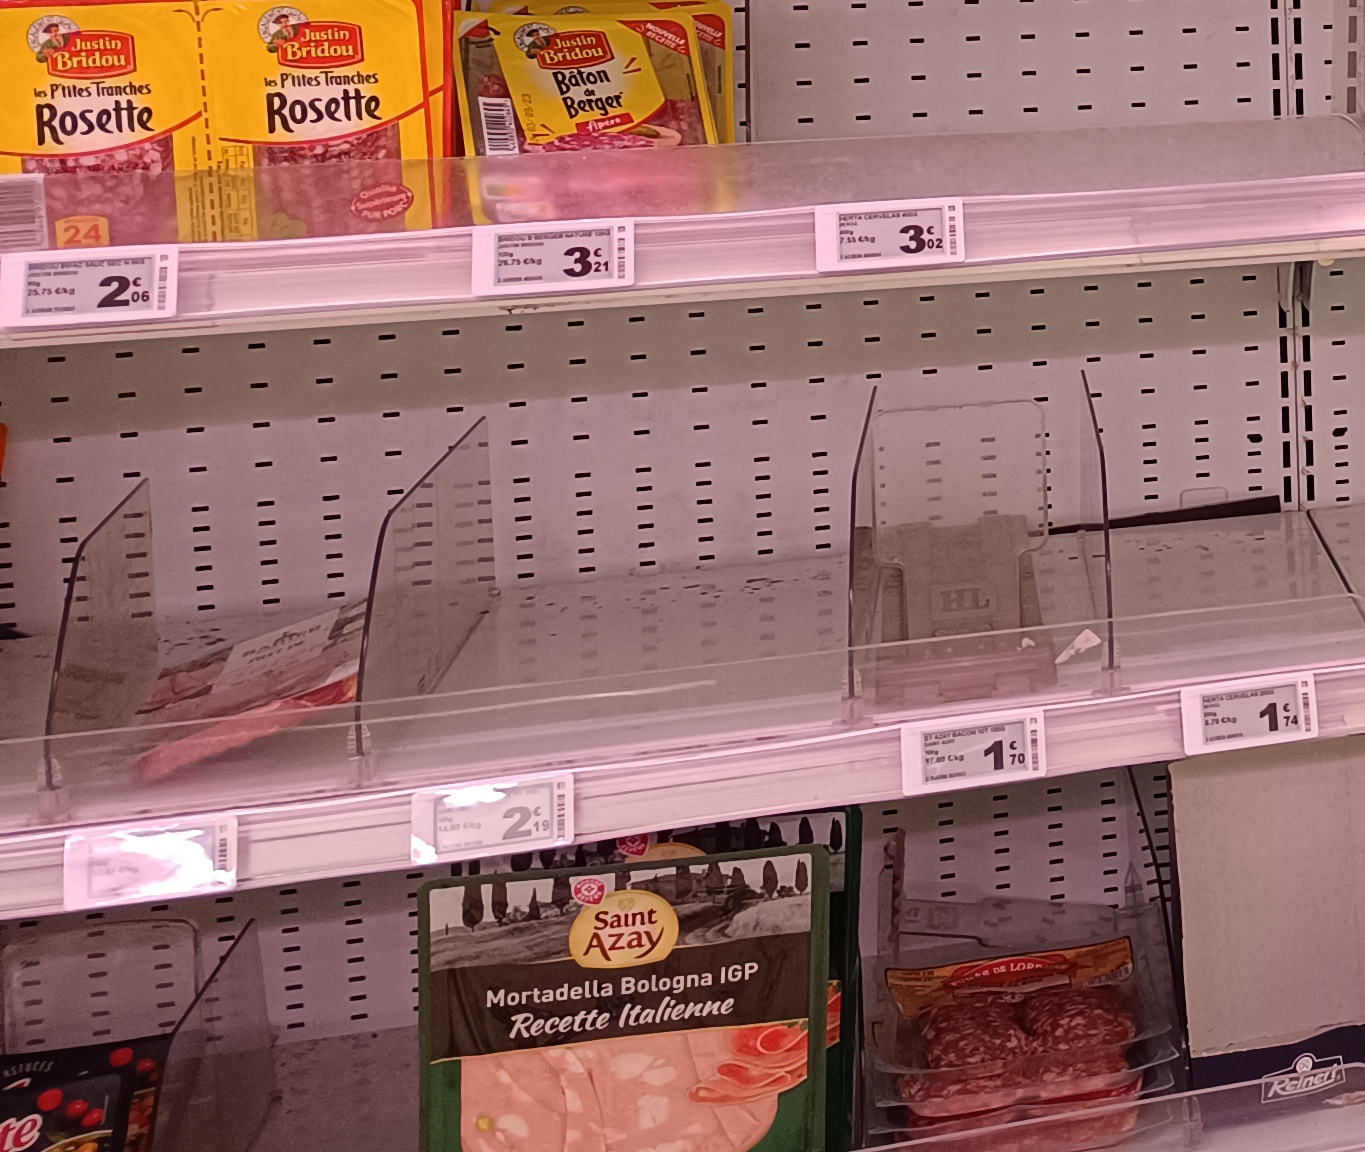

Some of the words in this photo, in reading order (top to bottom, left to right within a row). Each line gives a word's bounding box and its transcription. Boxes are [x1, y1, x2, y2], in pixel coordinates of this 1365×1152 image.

[71, 37, 122, 52] Justin
[300, 27, 350, 42] Justin
[555, 36, 597, 49] Justin
[52, 51, 126, 72] Bridou
[282, 41, 354, 61] Bridou
[540, 47, 604, 65] Bridou
[91, 80, 153, 98] Tranches
[319, 69, 379, 87] Tranches
[552, 68, 611, 96] Bâton
[265, 87, 383, 134] Rosette
[561, 91, 624, 119] Berger
[35, 98, 155, 146] Rosette
[63, 223, 103, 245] 24
[593, 907, 659, 931] Saint
[582, 925, 665, 962] Azay
[485, 980, 614, 1009] Mortadella
[620, 972, 714, 996] Bologna
[719, 962, 760, 986] IGP
[508, 1008, 611, 1040] Recette
[618, 996, 736, 1029] Italienne
[1267, 1063, 1339, 1099] Reinert
